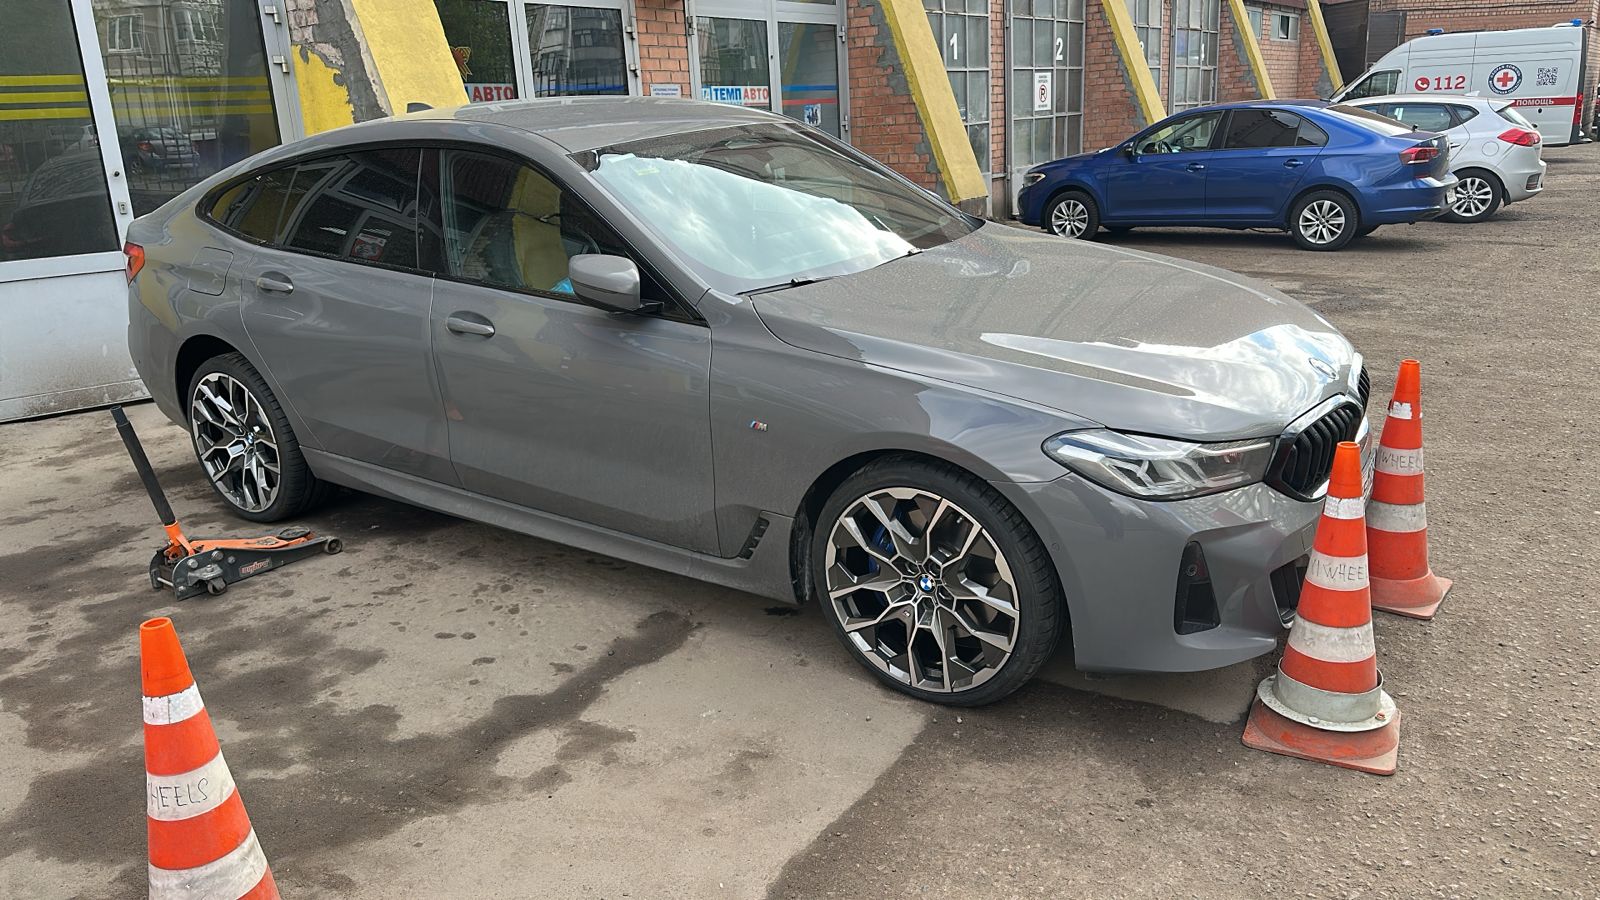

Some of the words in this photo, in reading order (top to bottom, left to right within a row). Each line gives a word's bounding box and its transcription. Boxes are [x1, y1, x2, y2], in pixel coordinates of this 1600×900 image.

[949, 33, 958, 60] 1
[1055, 37, 1064, 61] 2
[1433, 75, 1466, 91] 112
[472, 86, 514, 101] АВТО
[713, 88, 742, 101] ТЕМП
[743, 87, 769, 100] АВТО
[1516, 98, 1554, 106] ПОМОЩЬ
[1323, 563, 1368, 582] WHEE
[148, 777, 209, 810] HEELS
